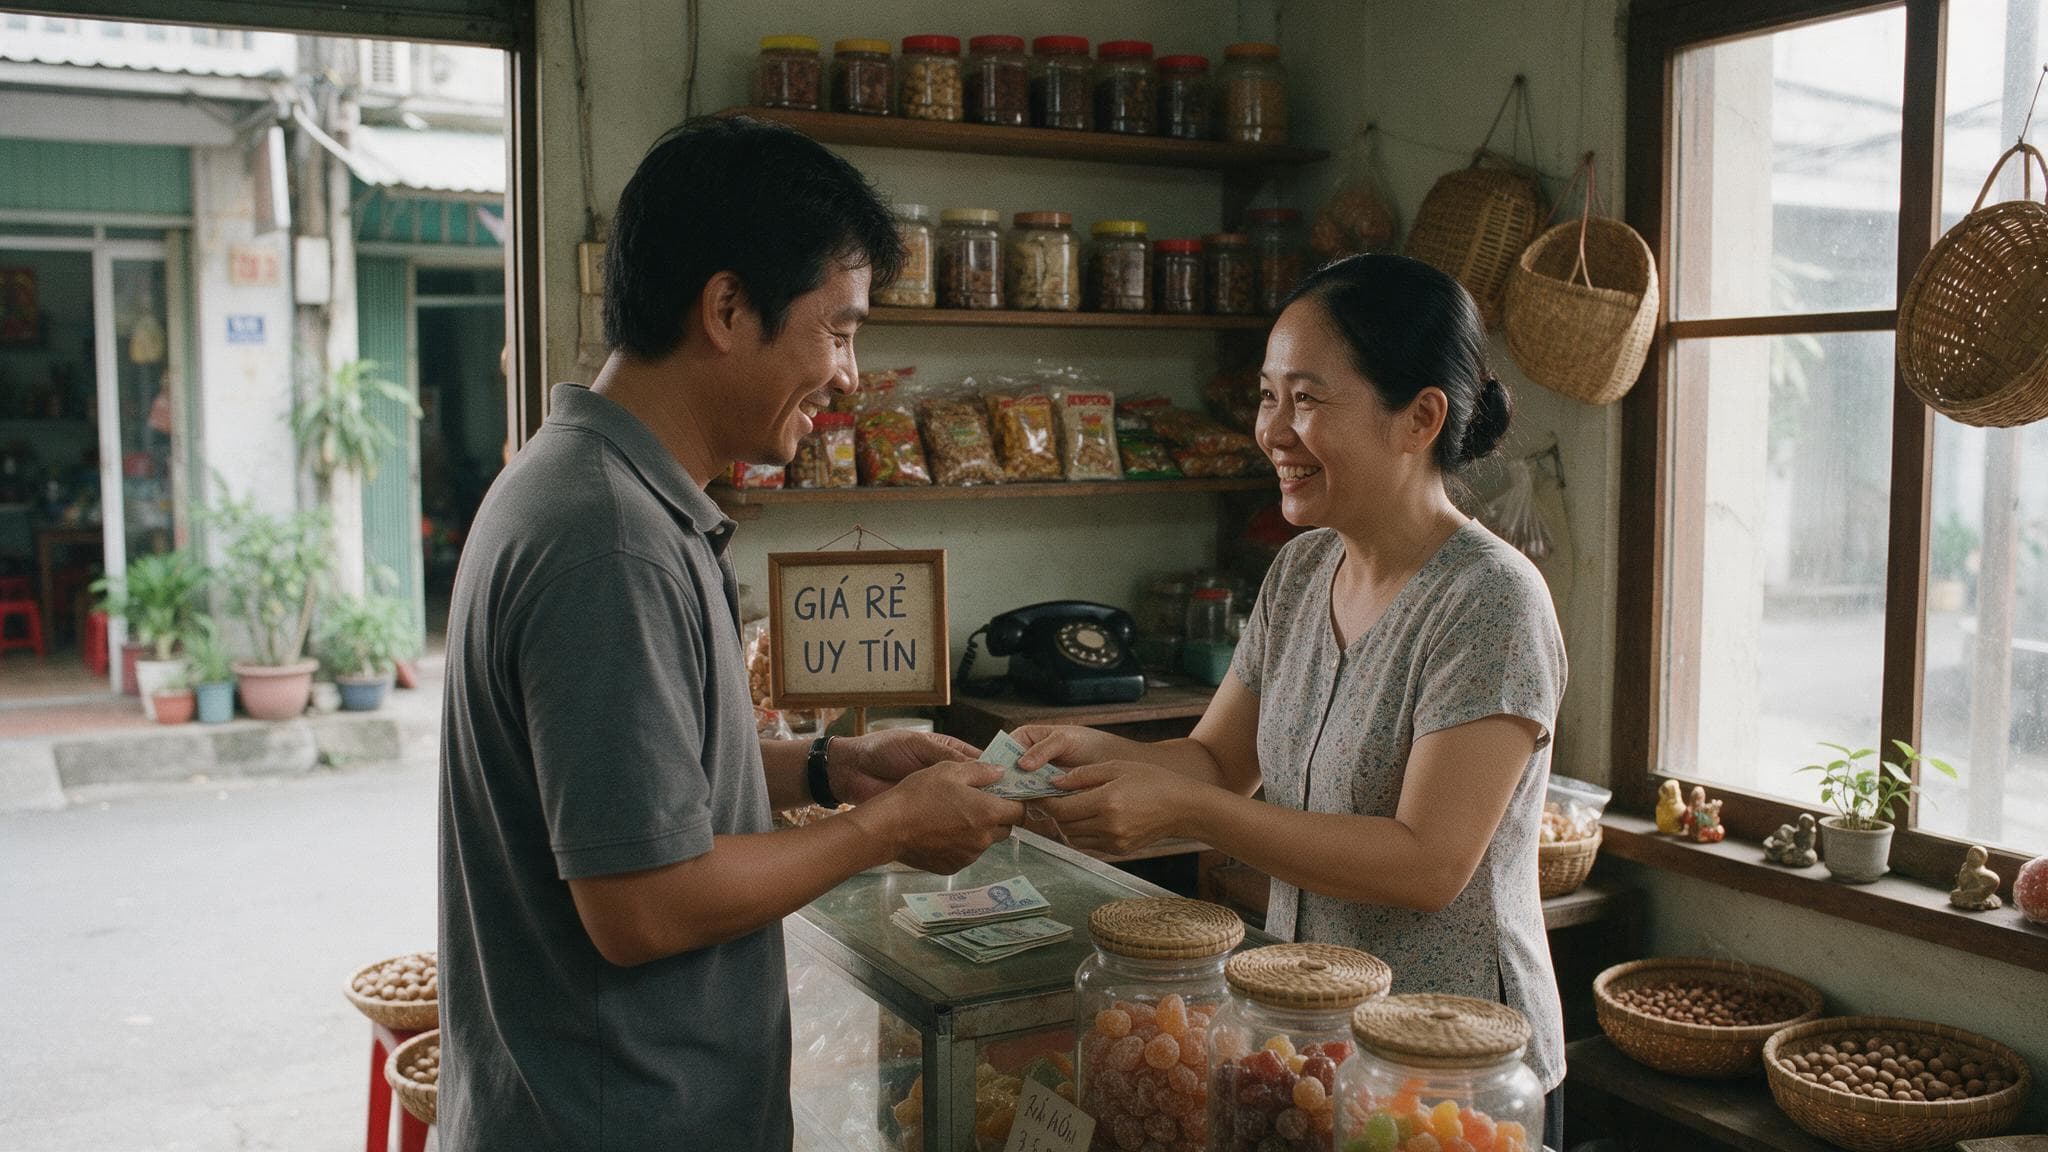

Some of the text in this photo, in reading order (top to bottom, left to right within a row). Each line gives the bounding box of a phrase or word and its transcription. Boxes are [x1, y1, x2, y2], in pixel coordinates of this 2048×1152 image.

[794, 573, 907, 620] GIÁ RẺ
[804, 629, 916, 674] UY TÍN
